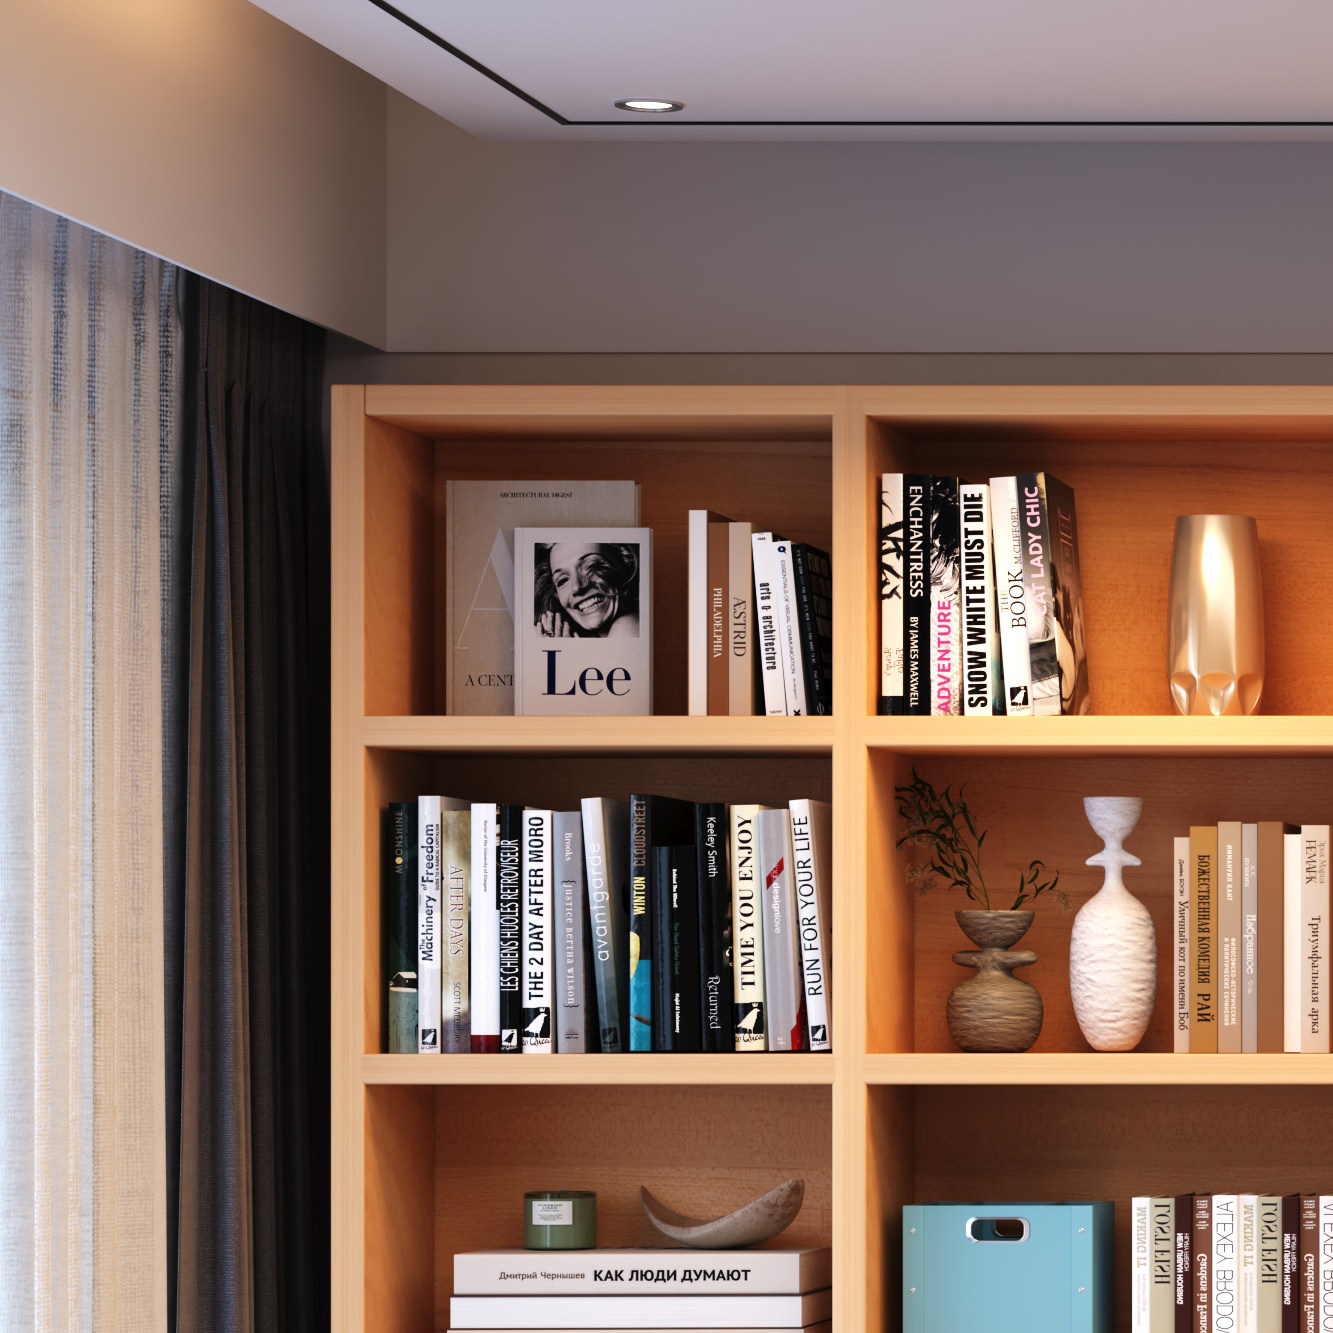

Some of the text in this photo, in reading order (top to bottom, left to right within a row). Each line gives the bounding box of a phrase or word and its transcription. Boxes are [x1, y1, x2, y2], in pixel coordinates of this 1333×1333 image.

[1024, 486, 1040, 528] CHIC
[909, 485, 923, 598] ENCHANTRESS
[1028, 533, 1044, 578] LADY
[759, 582, 772, 601] arts
[963, 494, 988, 708] SNOW WHITE MUST DIE
[713, 588, 723, 658] PHILADELPHIA
[733, 597, 746, 657] ÆSTRID
[762, 616, 777, 671] architecture
[541, 649, 632, 697] Lee
[937, 601, 951, 713] ADVENTURE
[706, 816, 718, 877] Keeley Smith
[528, 817, 544, 1001] THE 2 DAY AFTER MORO
[737, 816, 755, 991] TIME YOU ENJOY
[1196, 855, 1214, 1023] БОЖЕСТВЕННАЯ КОМЕДИЯ РАЙ
[707, 975, 721, 1029] Returned
[1308, 915, 1321, 1034] Триумфальная арка
[593, 1269, 751, 1284] КАК ЛЮДИ ДУМАЮТ
